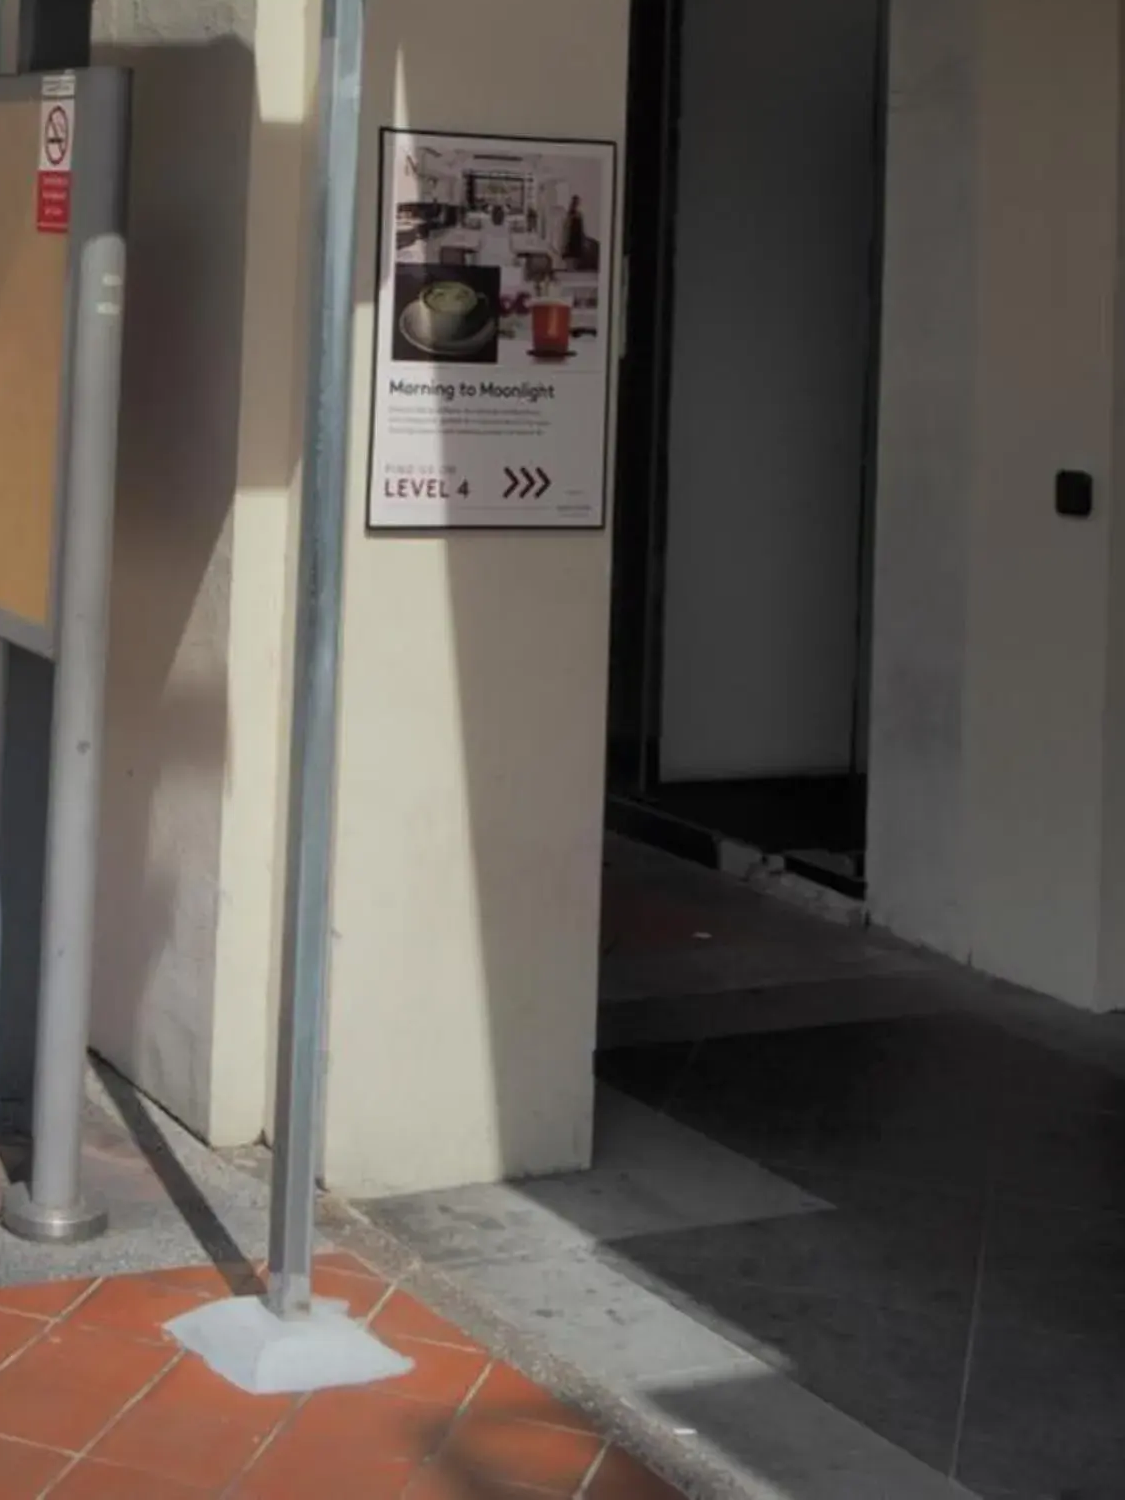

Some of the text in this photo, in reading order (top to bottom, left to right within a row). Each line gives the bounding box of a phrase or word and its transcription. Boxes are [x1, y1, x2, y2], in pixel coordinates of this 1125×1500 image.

[389, 380, 556, 402] Morning to Moonlight
[384, 478, 470, 499] LEVEL 4
